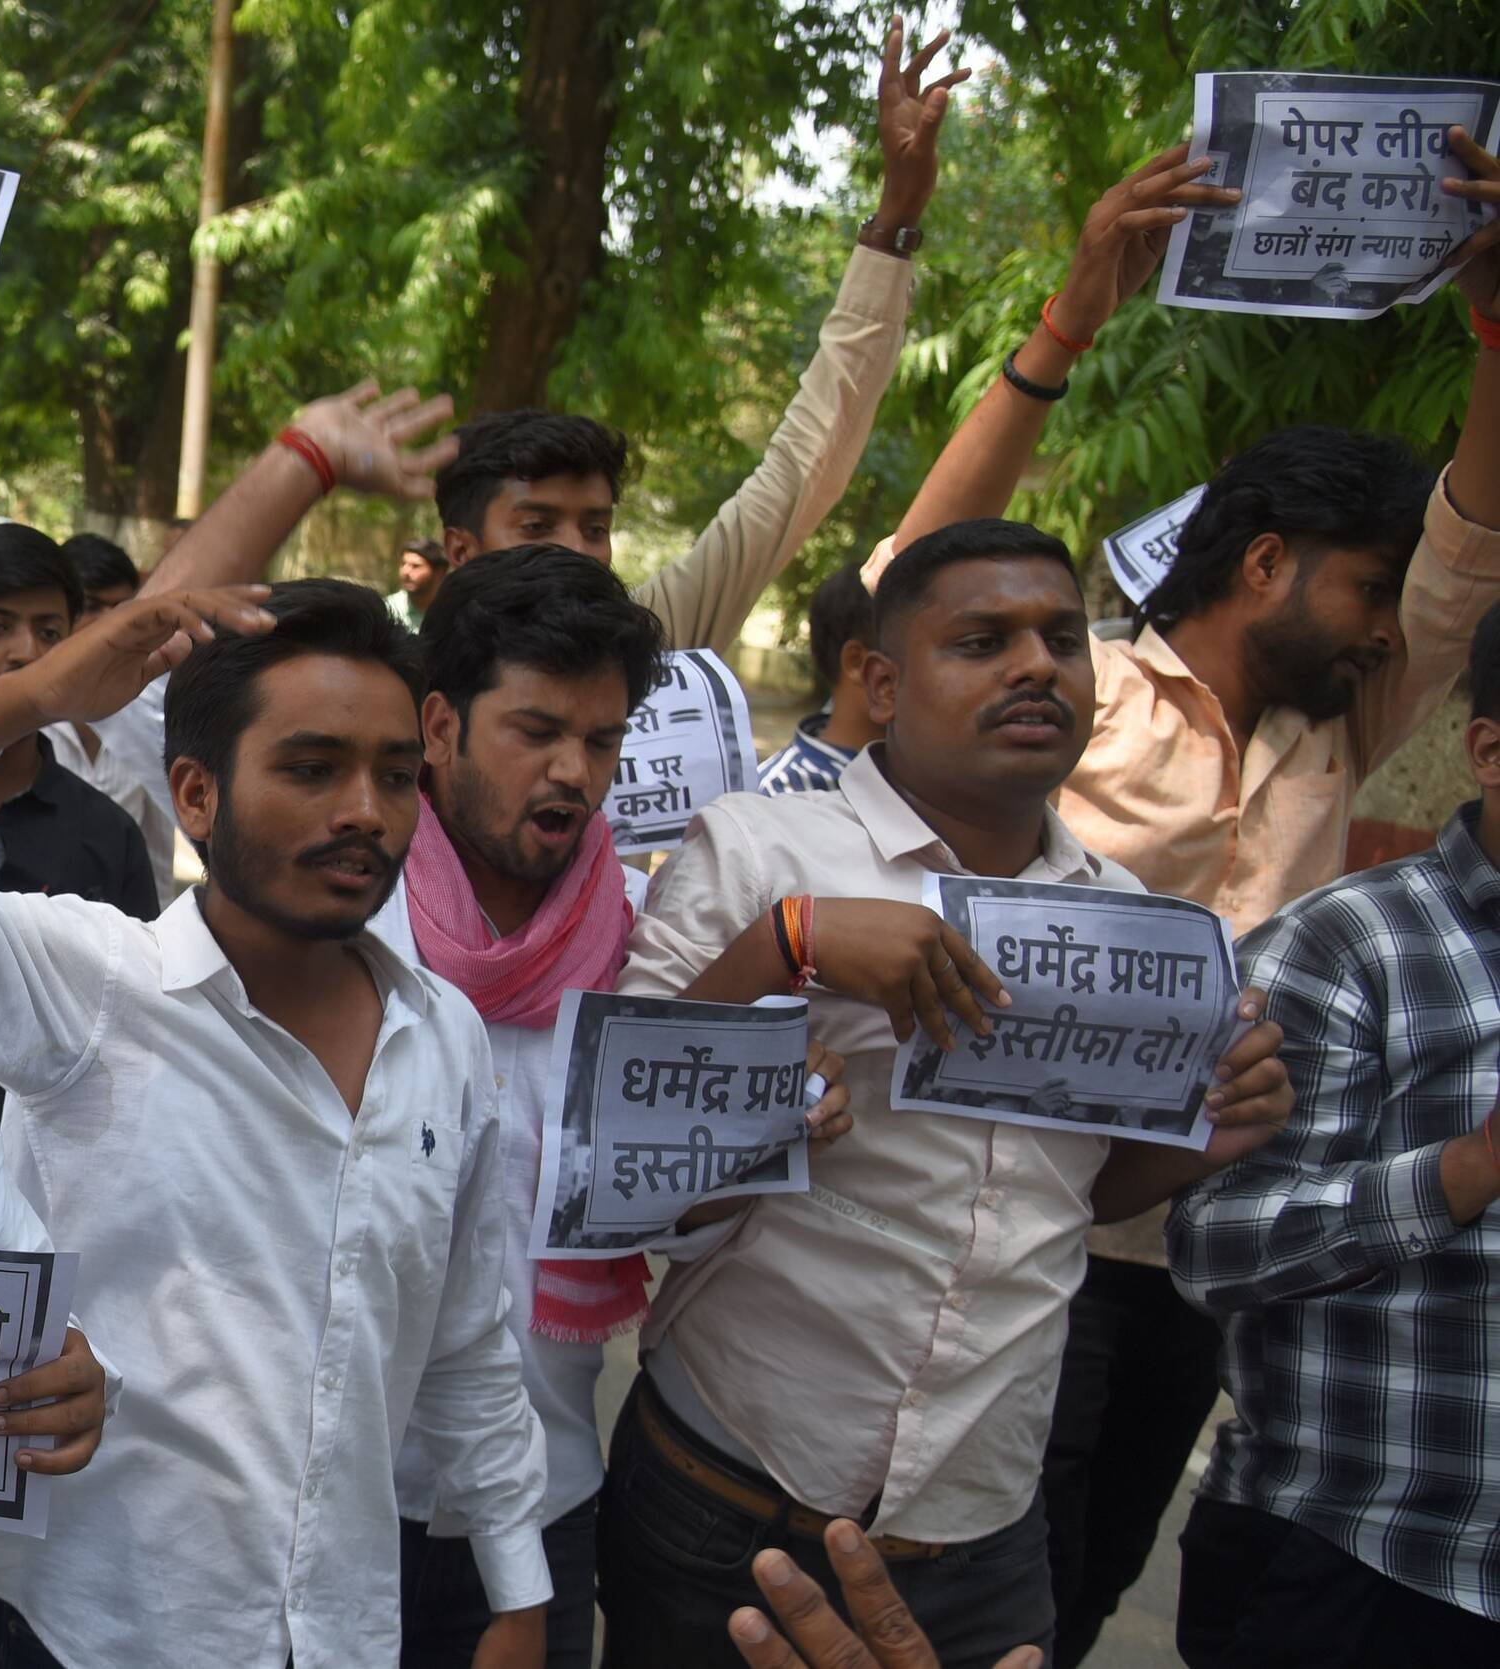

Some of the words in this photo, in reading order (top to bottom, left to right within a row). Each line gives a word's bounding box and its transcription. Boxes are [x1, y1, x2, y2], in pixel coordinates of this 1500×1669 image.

[1281, 107, 1363, 157] पेपर
[1291, 159, 1352, 211] बंद
[1362, 162, 1440, 217] करो,
[1254, 225, 1312, 257] छात्रों
[1316, 226, 1356, 258] संग
[1362, 234, 1414, 259] न्याय
[647, 754, 683, 778] पर
[996, 924, 1100, 994] धर्मेंद्र
[1108, 947, 1207, 1001] प्रधान
[968, 1004, 1133, 1066] इस्तीफा
[1133, 1017, 1199, 1074] दो!
[621, 1045, 737, 1114] धर्मेंद्र
[743, 1059, 806, 1112] प्रधा
